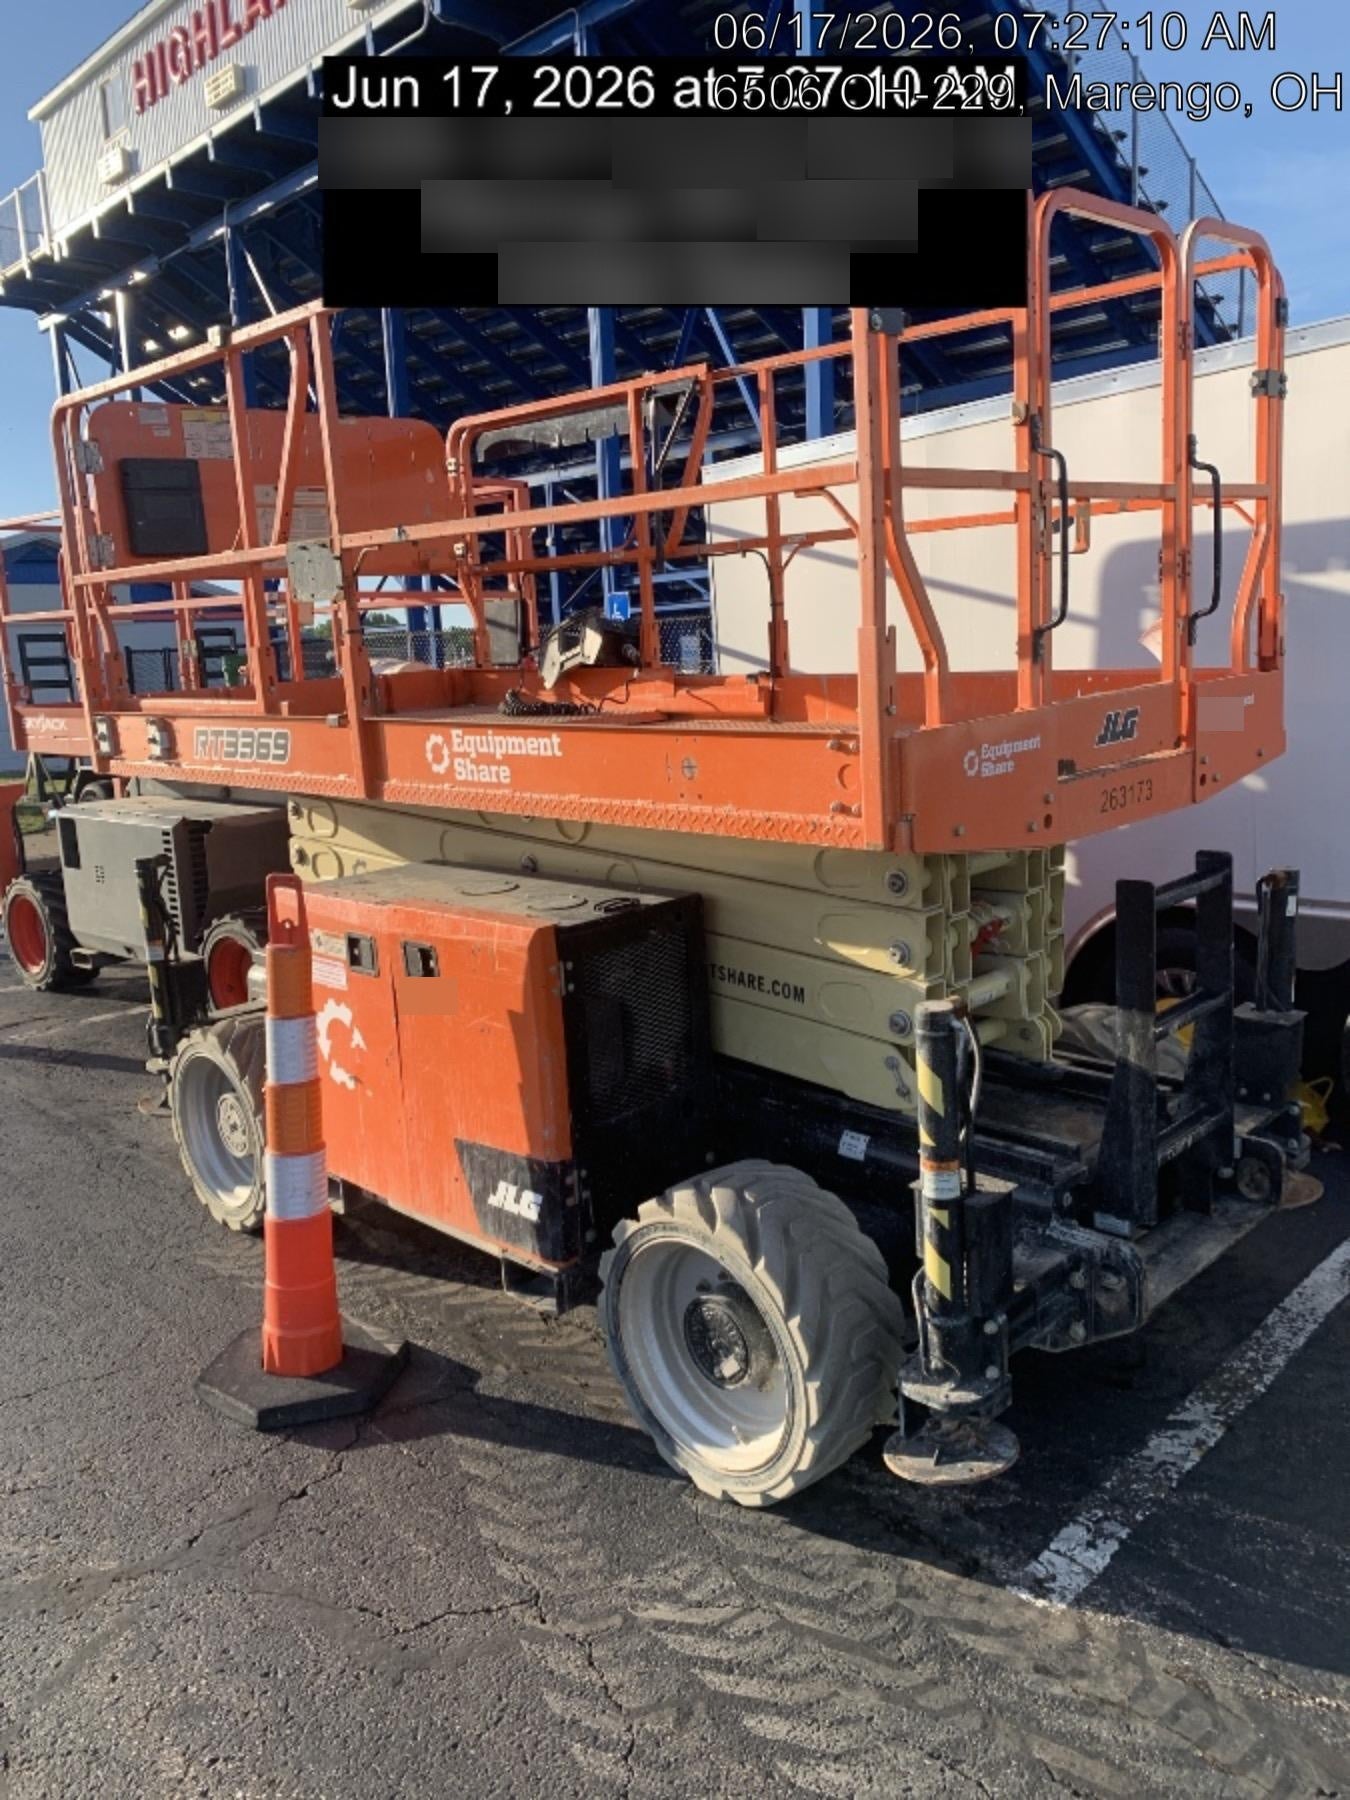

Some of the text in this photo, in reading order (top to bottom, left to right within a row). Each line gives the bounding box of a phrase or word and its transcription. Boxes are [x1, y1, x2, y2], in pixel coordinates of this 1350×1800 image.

[131, 0, 288, 116] HIGHLA
[193, 726, 290, 765] RT3369
[451, 728, 563, 760] Equipment
[1093, 705, 1141, 749] JLG
[981, 733, 1041, 760] Equipment
[453, 757, 511, 784] Share
[1100, 779, 1153, 814] 263173
[487, 1179, 544, 1223] JLG
